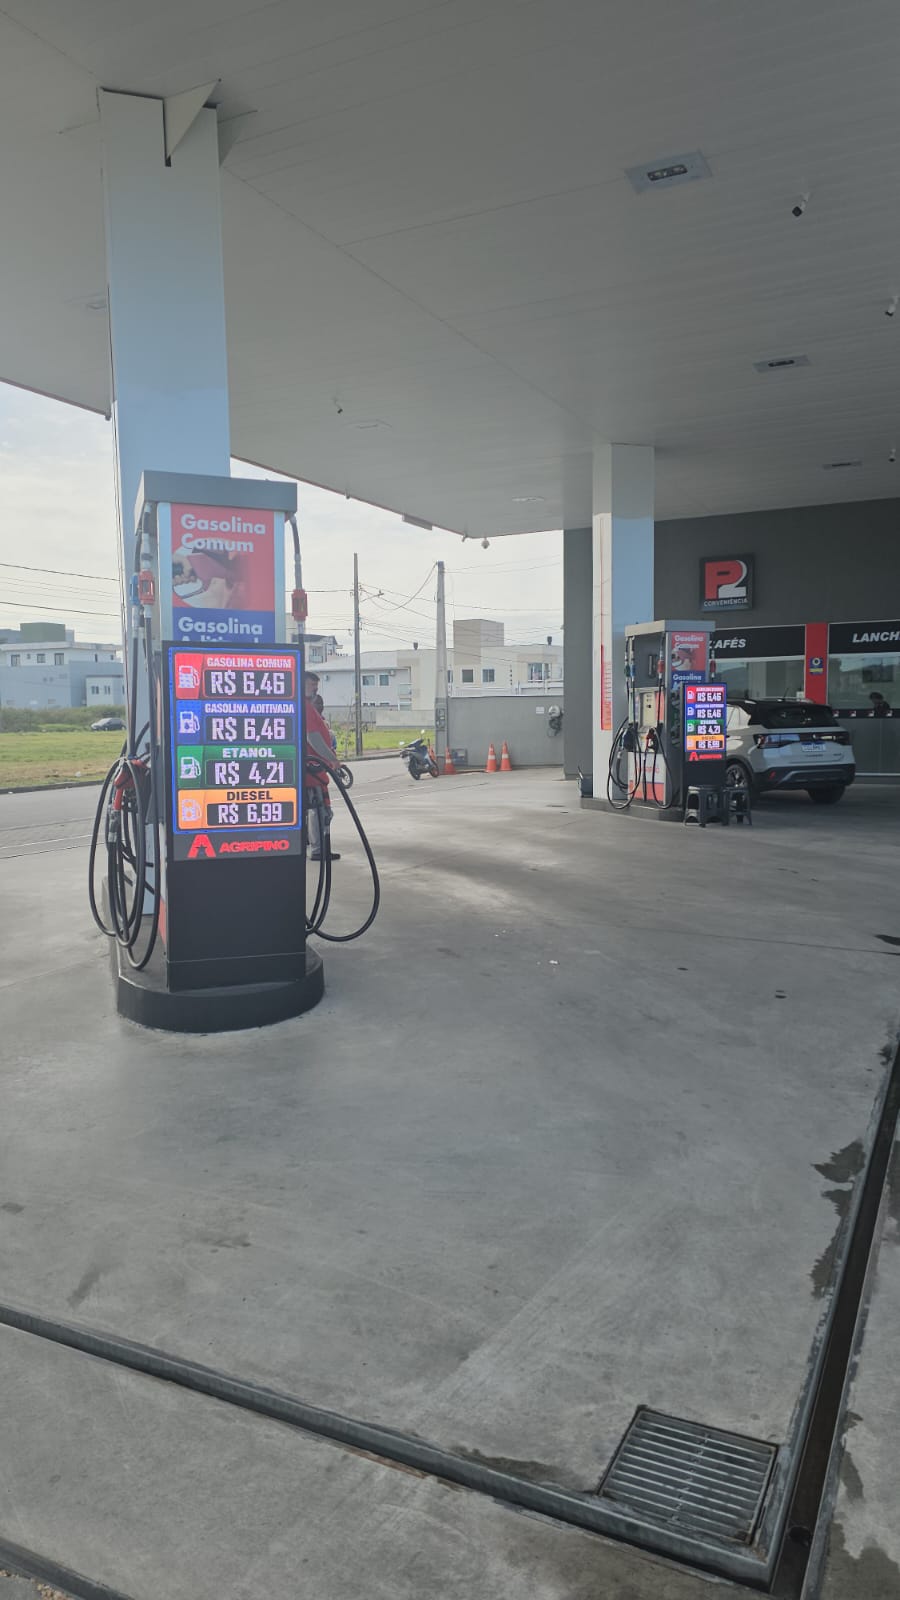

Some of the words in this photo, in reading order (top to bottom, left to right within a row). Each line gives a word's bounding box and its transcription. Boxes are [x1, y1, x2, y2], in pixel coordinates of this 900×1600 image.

[181, 513, 266, 535] Gasolina
[181, 533, 254, 553] Comum
[178, 616, 263, 635] Gasolina
[206, 657, 254, 668] GASOLINA
[256, 658, 292, 669] COMUM
[211, 669, 236, 696] R$
[243, 671, 285, 696] 6,46
[204, 703, 248, 714] GASOLINA
[250, 703, 295, 714] ADITIVADA
[212, 716, 238, 742] R$
[244, 718, 286, 742] 6,46
[222, 747, 276, 759] ETANOL
[214, 760, 240, 787] R$
[248, 761, 284, 786] 4,21
[226, 790, 273, 801] DIESEL
[218, 802, 239, 825] R$
[247, 802, 282, 824] 6,99
[219, 839, 290, 853] AGRIPINO
